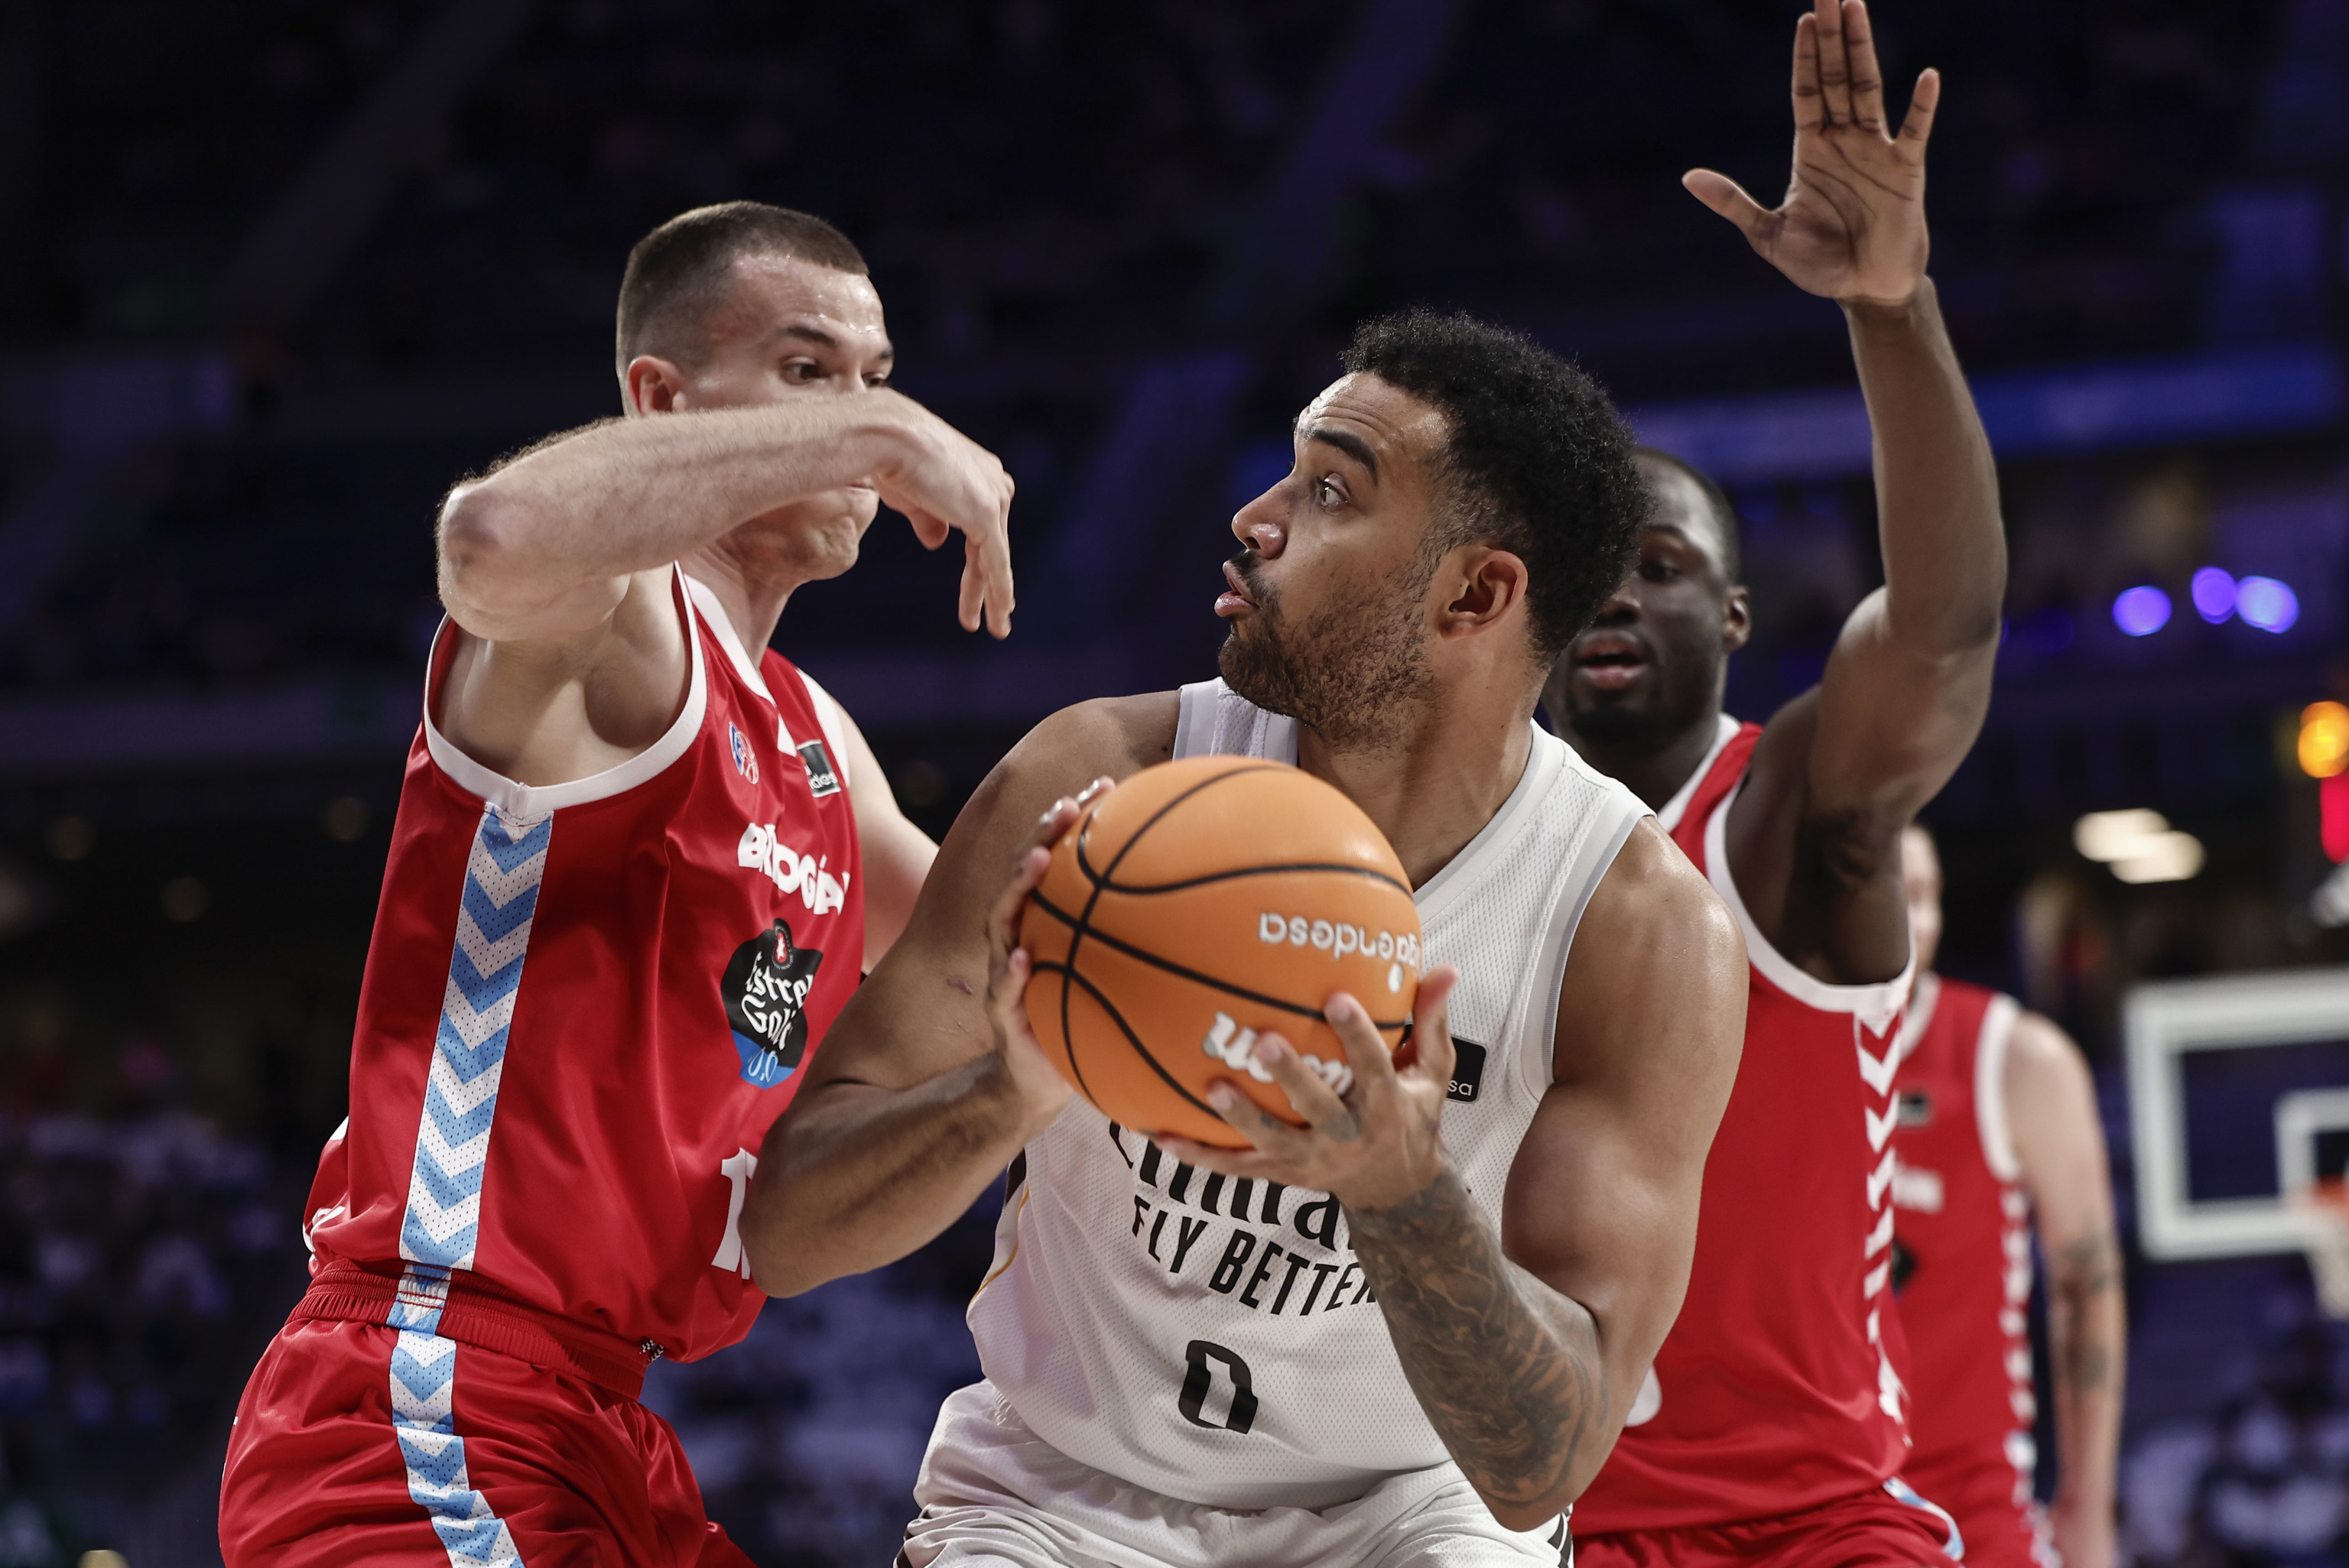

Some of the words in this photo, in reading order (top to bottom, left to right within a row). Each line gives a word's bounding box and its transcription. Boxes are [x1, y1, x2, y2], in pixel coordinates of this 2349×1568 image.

[741, 994, 798, 1050] Gali
[1132, 1194, 1210, 1274] FLY
[1178, 1339, 1259, 1434] 0
